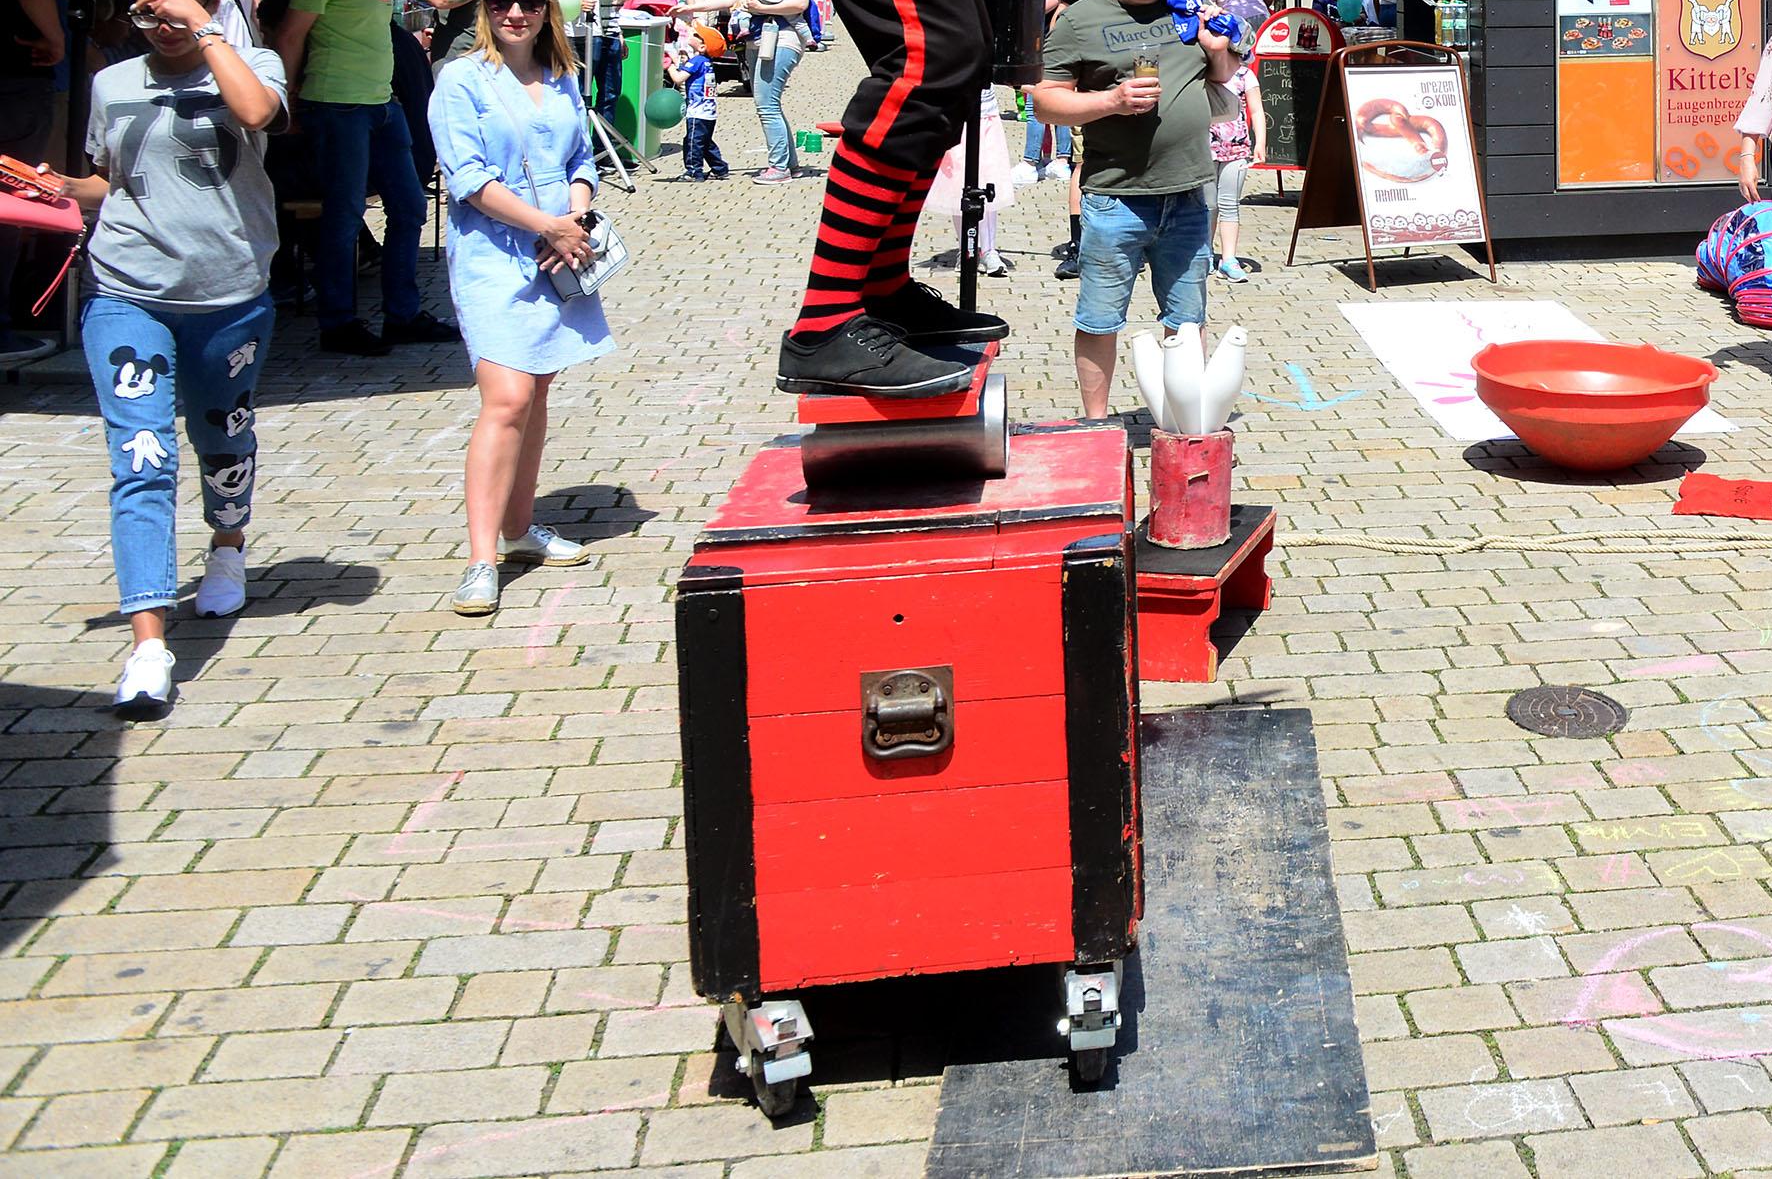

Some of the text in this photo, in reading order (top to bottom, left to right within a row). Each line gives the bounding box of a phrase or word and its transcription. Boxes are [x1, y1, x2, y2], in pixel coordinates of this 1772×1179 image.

[1109, 23, 1176, 46] Marc O'P
[1667, 67, 1756, 91] Kittel's
